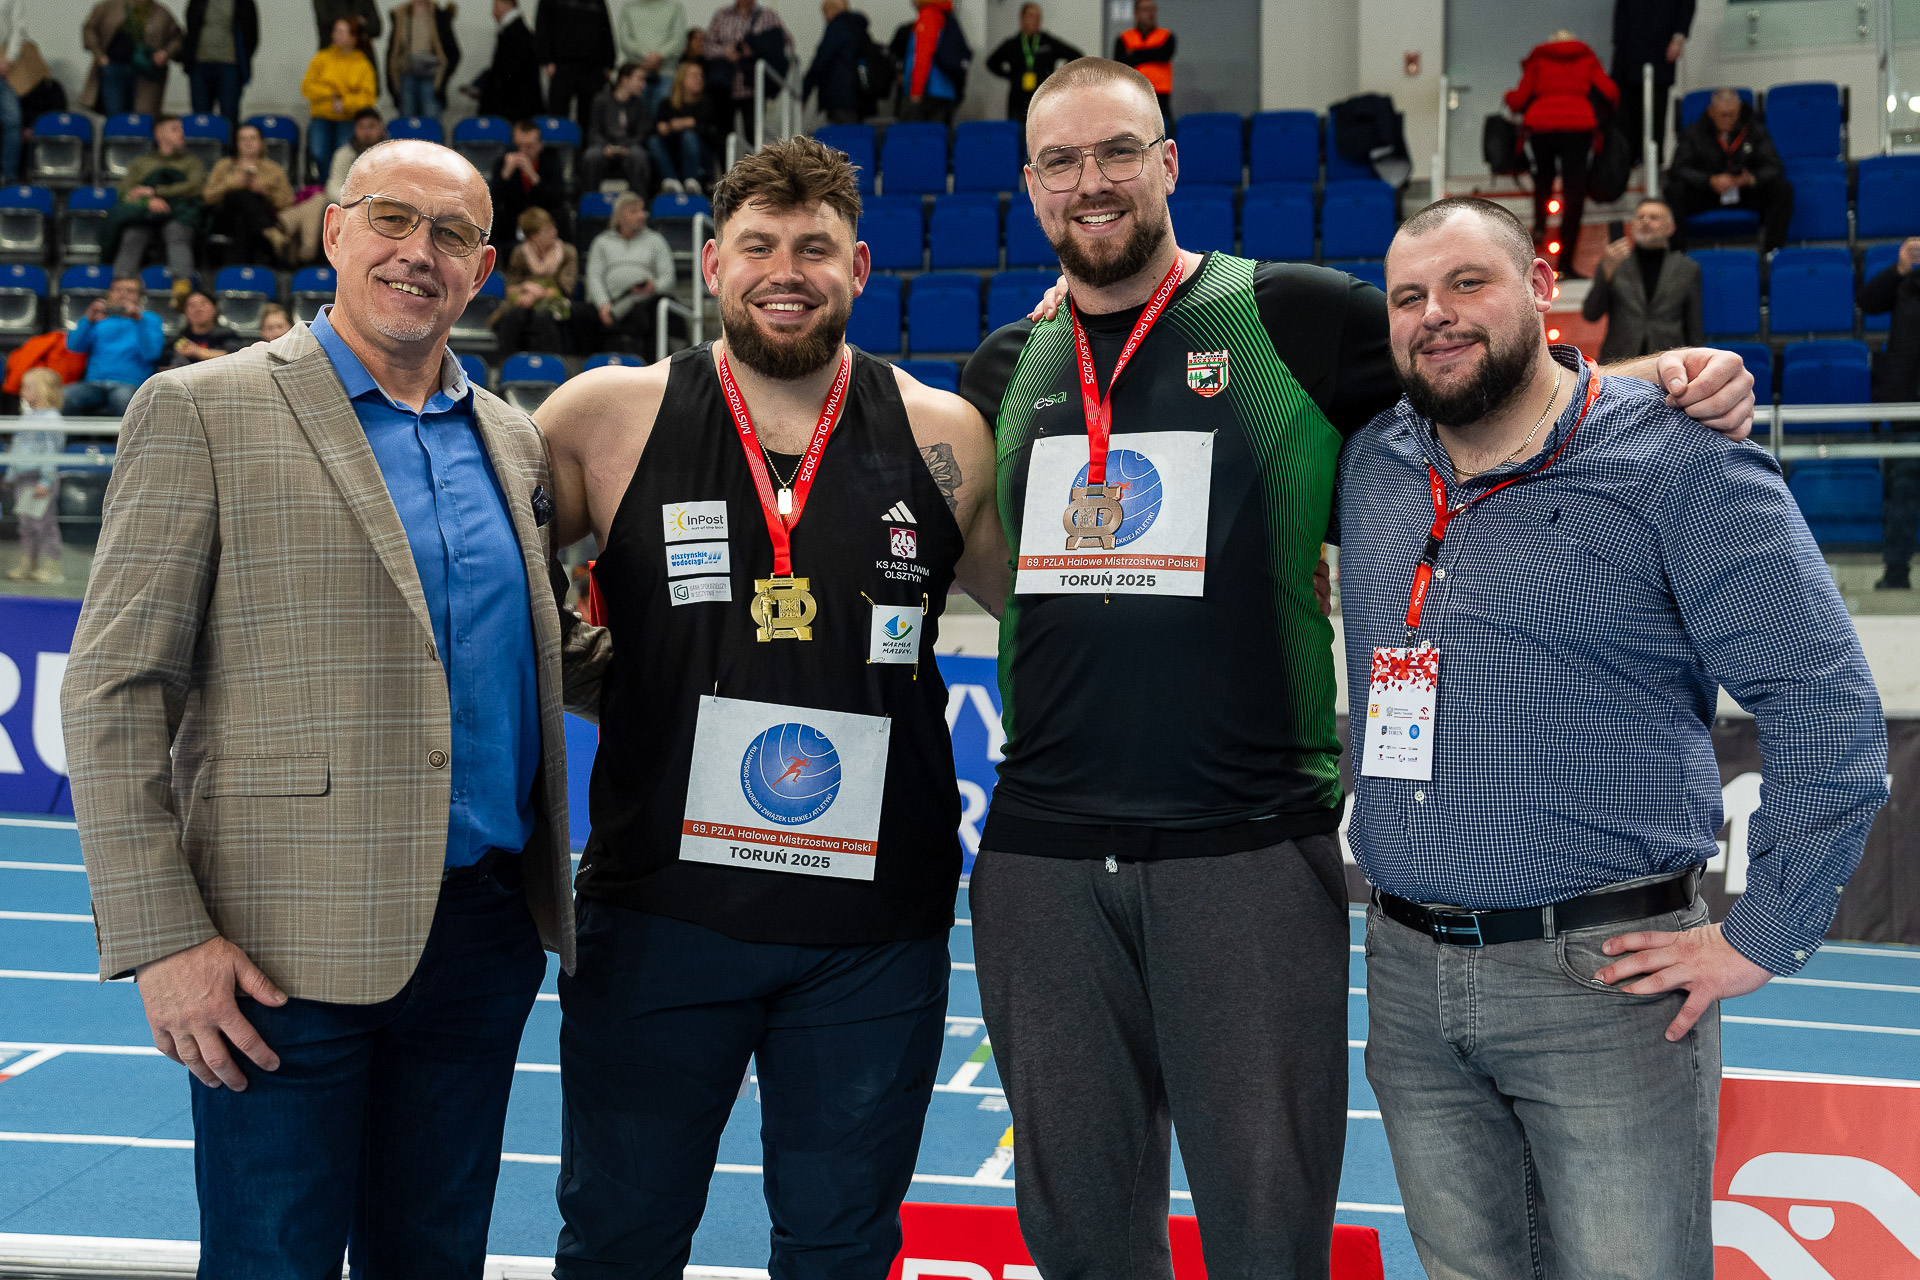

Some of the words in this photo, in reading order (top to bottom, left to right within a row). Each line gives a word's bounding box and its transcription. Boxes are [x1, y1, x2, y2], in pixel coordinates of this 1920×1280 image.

[1122, 322, 1148, 358] POLSKI
[1082, 361, 1095, 384] 2025
[720, 360, 752, 434] MISTRZOSTWA
[810, 416, 831, 454] POLSKI
[800, 454, 818, 482] 2025
[687, 514, 724, 525] InPost
[1115, 534, 1135, 545] EKKIEJ
[1134, 511, 1156, 536] ATLETYKI
[670, 551, 708, 560] olsztyńskie
[671, 558, 704, 567] wodociągi
[1026, 558, 1041, 567] 69.
[1043, 558, 1065, 567] PZLA
[1066, 557, 1103, 567] Halowe
[1104, 556, 1165, 567] Mistrzostwa
[1167, 558, 1199, 569] Polski
[876, 560, 889, 569] KS
[890, 561, 908, 571] AZS
[910, 563, 930, 577] UWM
[884, 570, 922, 583] OLSZTYN
[1059, 571, 1113, 586] TORUŃ
[1115, 574, 1156, 587] 2025
[743, 744, 763, 810] KUJAWSKO-POMORSKI
[760, 807, 787, 822] ZWIĄZEK
[787, 812, 812, 823] LEKKIEJ
[812, 793, 833, 816] ATLETYKI
[692, 823, 709, 834] 69.
[711, 826, 735, 837] PZLA
[737, 829, 777, 842] Halowe
[779, 834, 840, 849] Mistrzostwa
[842, 841, 872, 853] Polski
[729, 846, 787, 865] TORUŃ
[790, 853, 831, 869] 2025
